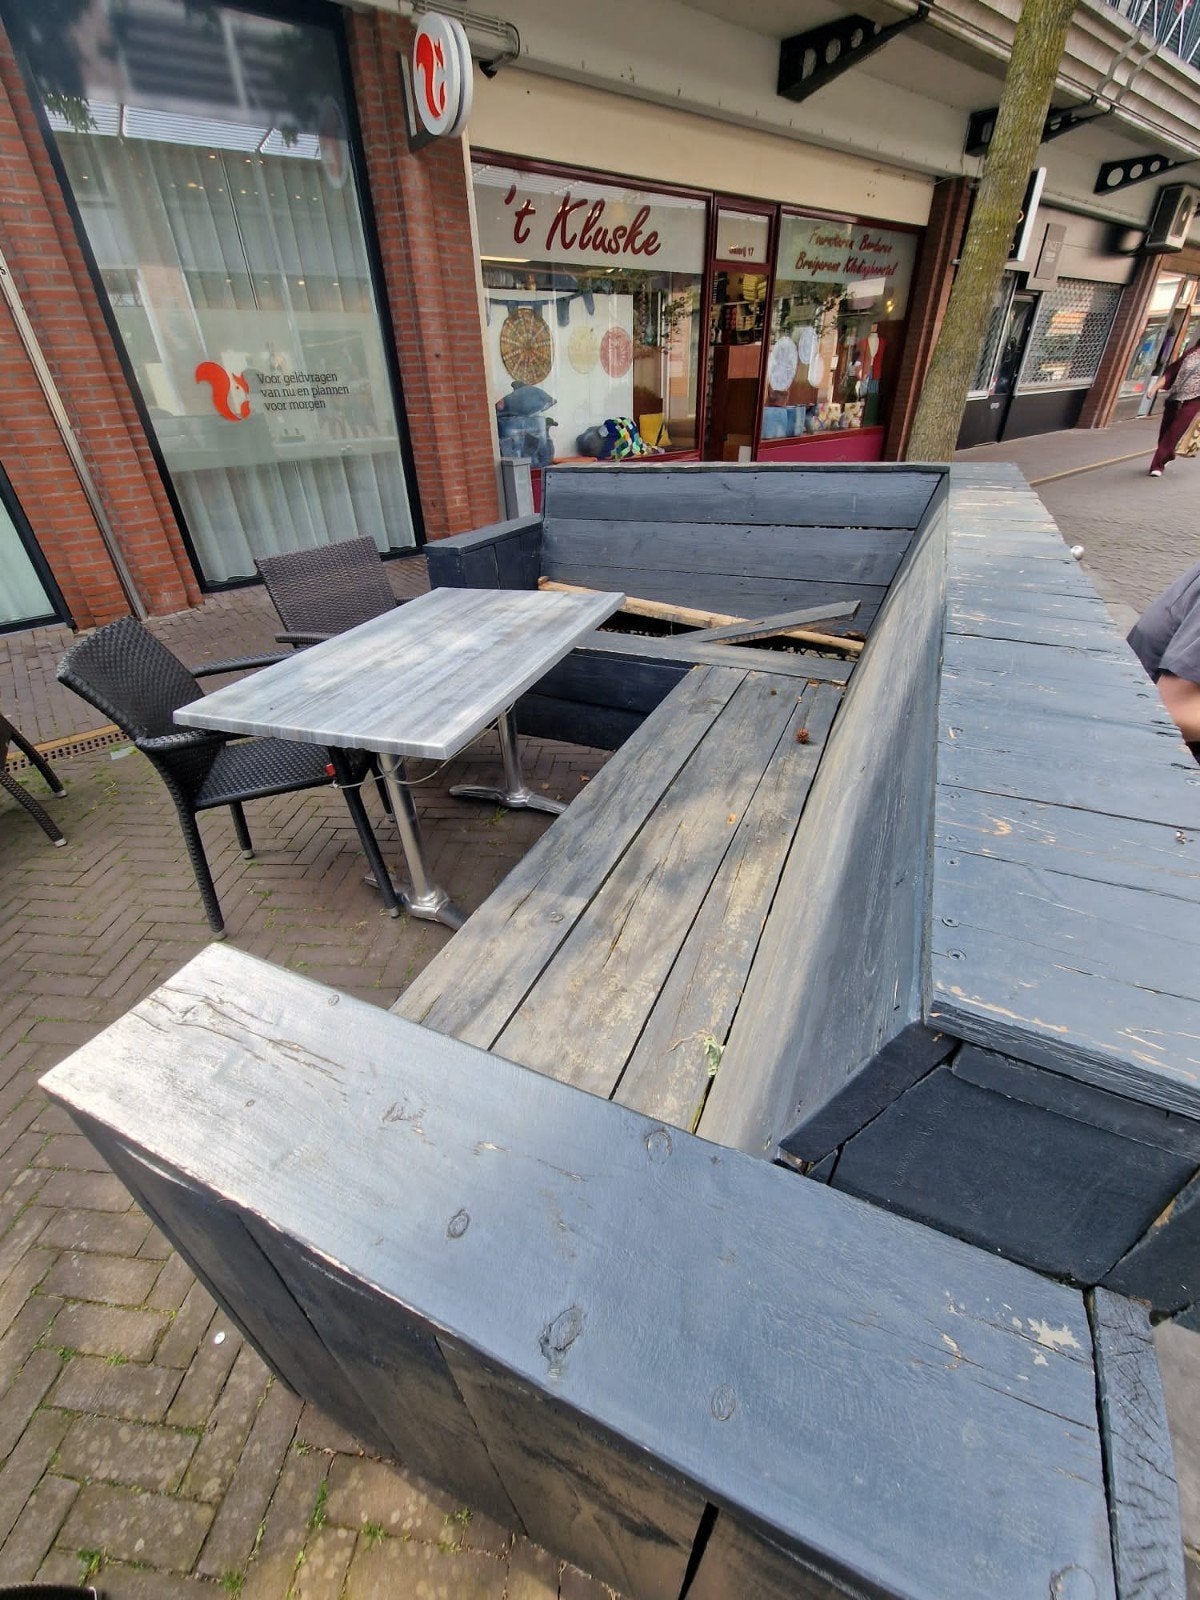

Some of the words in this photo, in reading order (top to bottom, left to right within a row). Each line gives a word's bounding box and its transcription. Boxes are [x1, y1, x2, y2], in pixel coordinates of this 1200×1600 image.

[504, 184, 536, 244] 't
[545, 191, 661, 256] Kluske
[256, 373, 282, 385] Voor
[283, 371, 338, 386] geldvragen
[260, 388, 281, 398] van
[282, 387, 296, 397] nu
[297, 387, 310, 396] en
[311, 385, 350, 399] plannen
[264, 402, 287, 411] voor
[289, 399, 326, 412] morgen
